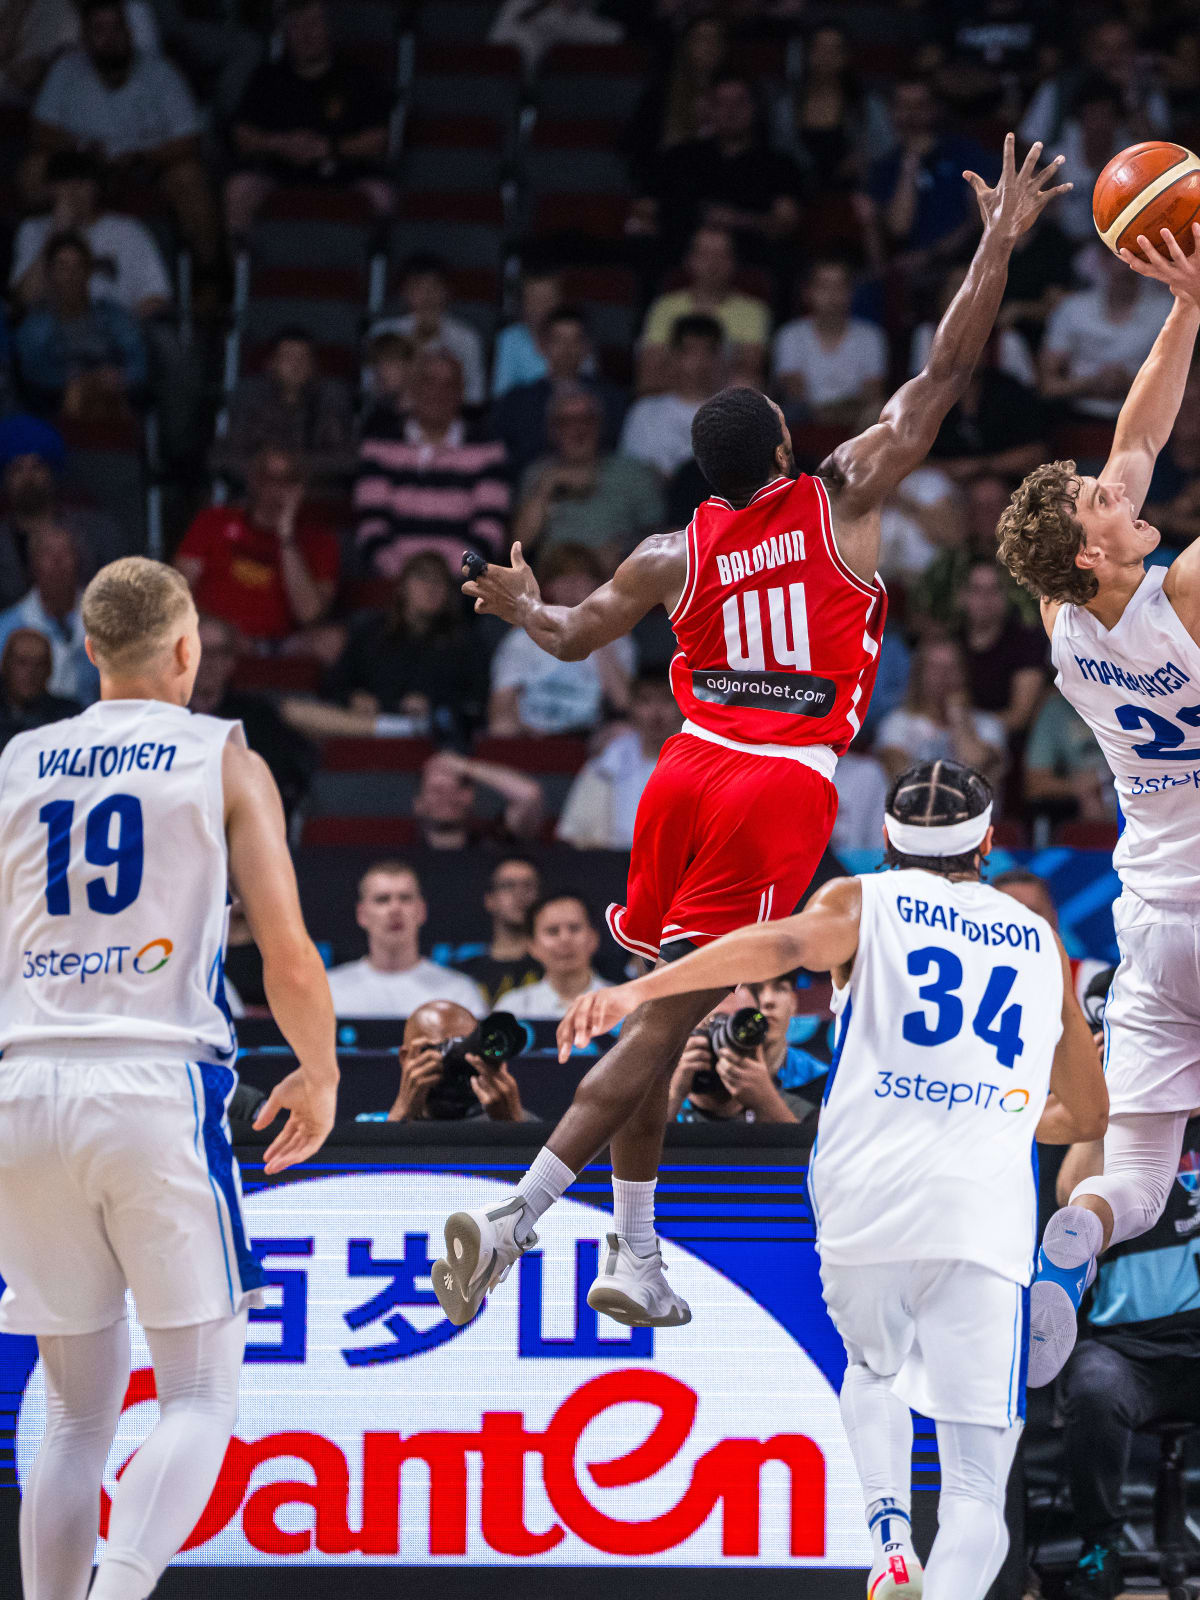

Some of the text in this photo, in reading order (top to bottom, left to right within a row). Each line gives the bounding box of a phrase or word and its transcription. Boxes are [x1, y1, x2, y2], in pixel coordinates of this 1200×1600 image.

[715, 529, 807, 586] BALDWIN
[722, 582, 812, 672] 44
[706, 676, 826, 705] adjarabet.com
[38, 742, 177, 779] VALTONEN
[39, 793, 144, 916] 19
[896, 895, 1041, 953] GRANDISON
[23, 946, 131, 984] 3stepIT
[902, 946, 1025, 1069] 34
[874, 1071, 1000, 1111] 3stepIT
